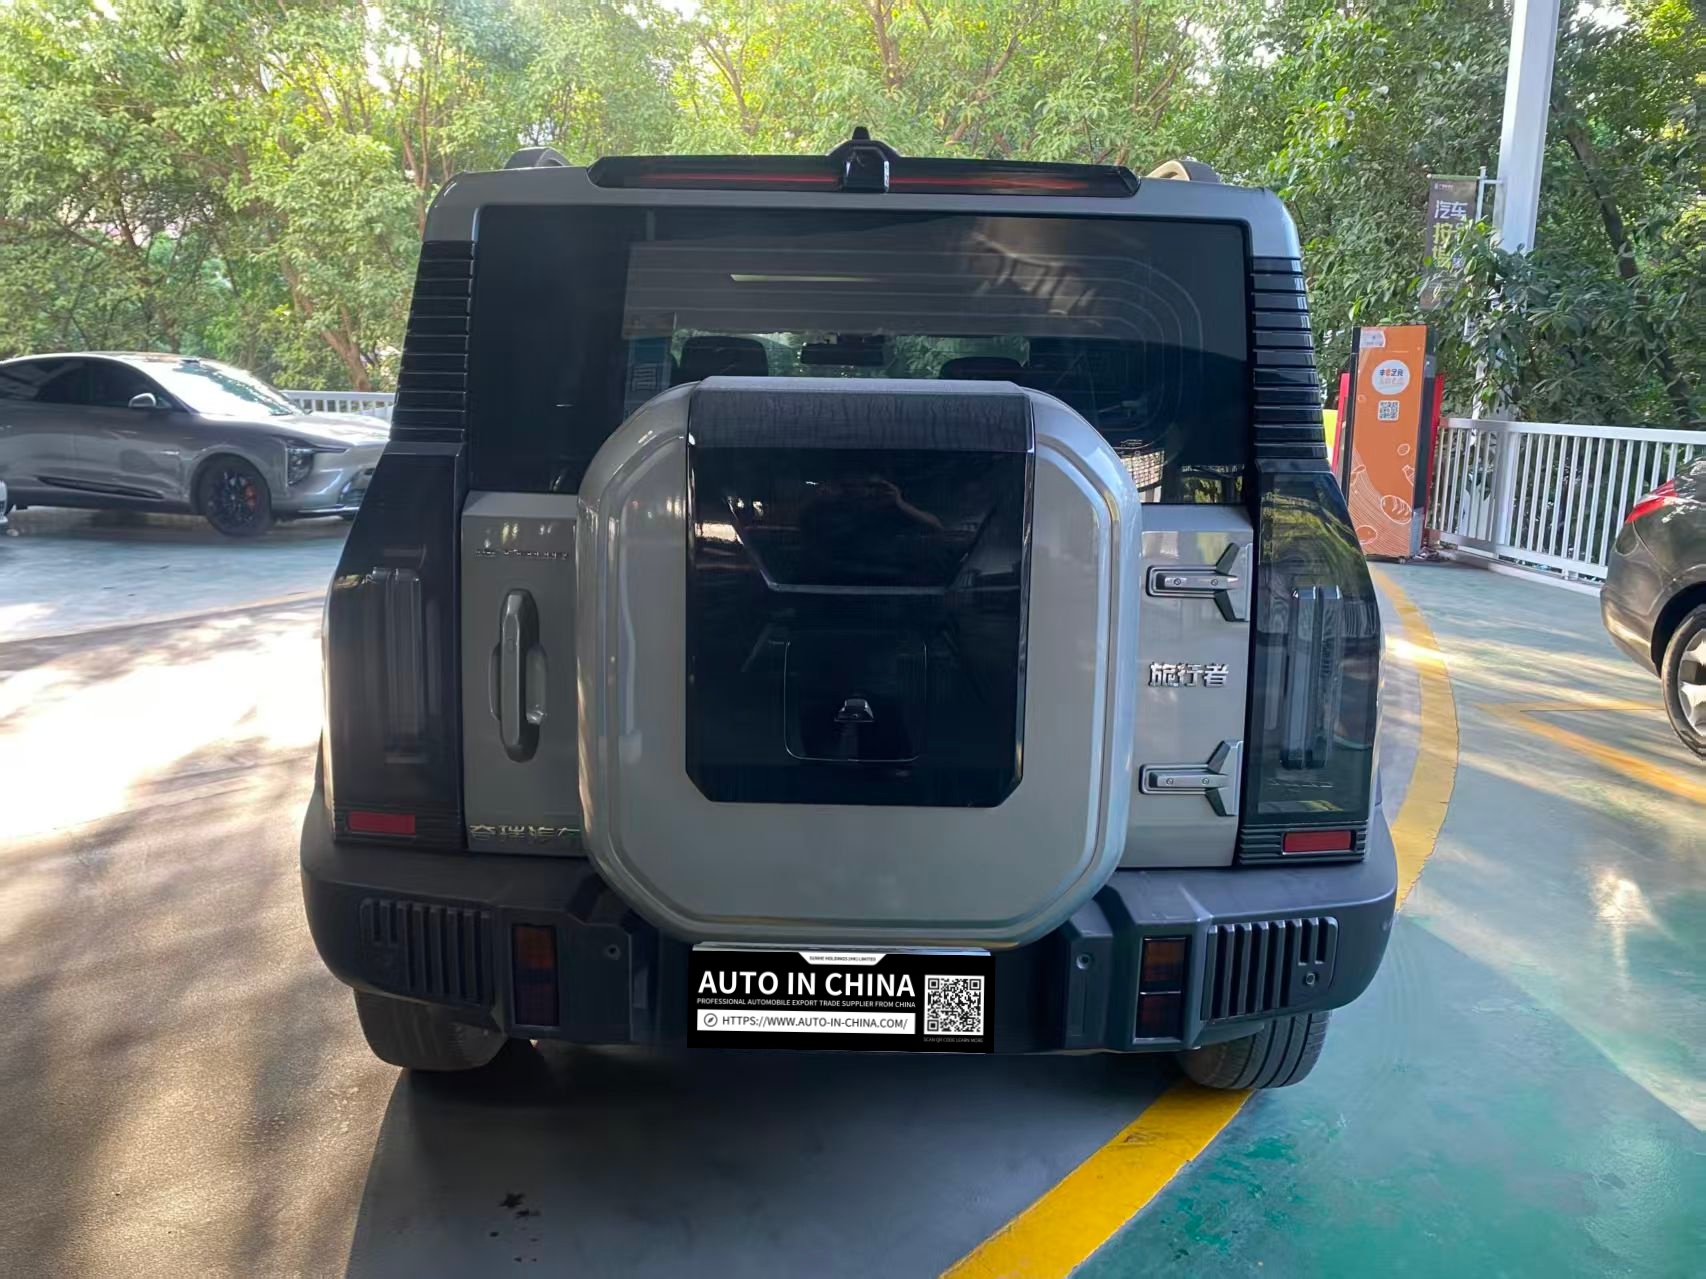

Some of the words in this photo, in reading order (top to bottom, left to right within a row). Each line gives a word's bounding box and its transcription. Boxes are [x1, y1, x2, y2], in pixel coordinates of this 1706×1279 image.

[1434, 199, 1468, 219] 汽车
[1148, 662, 1229, 687] 旅行者
